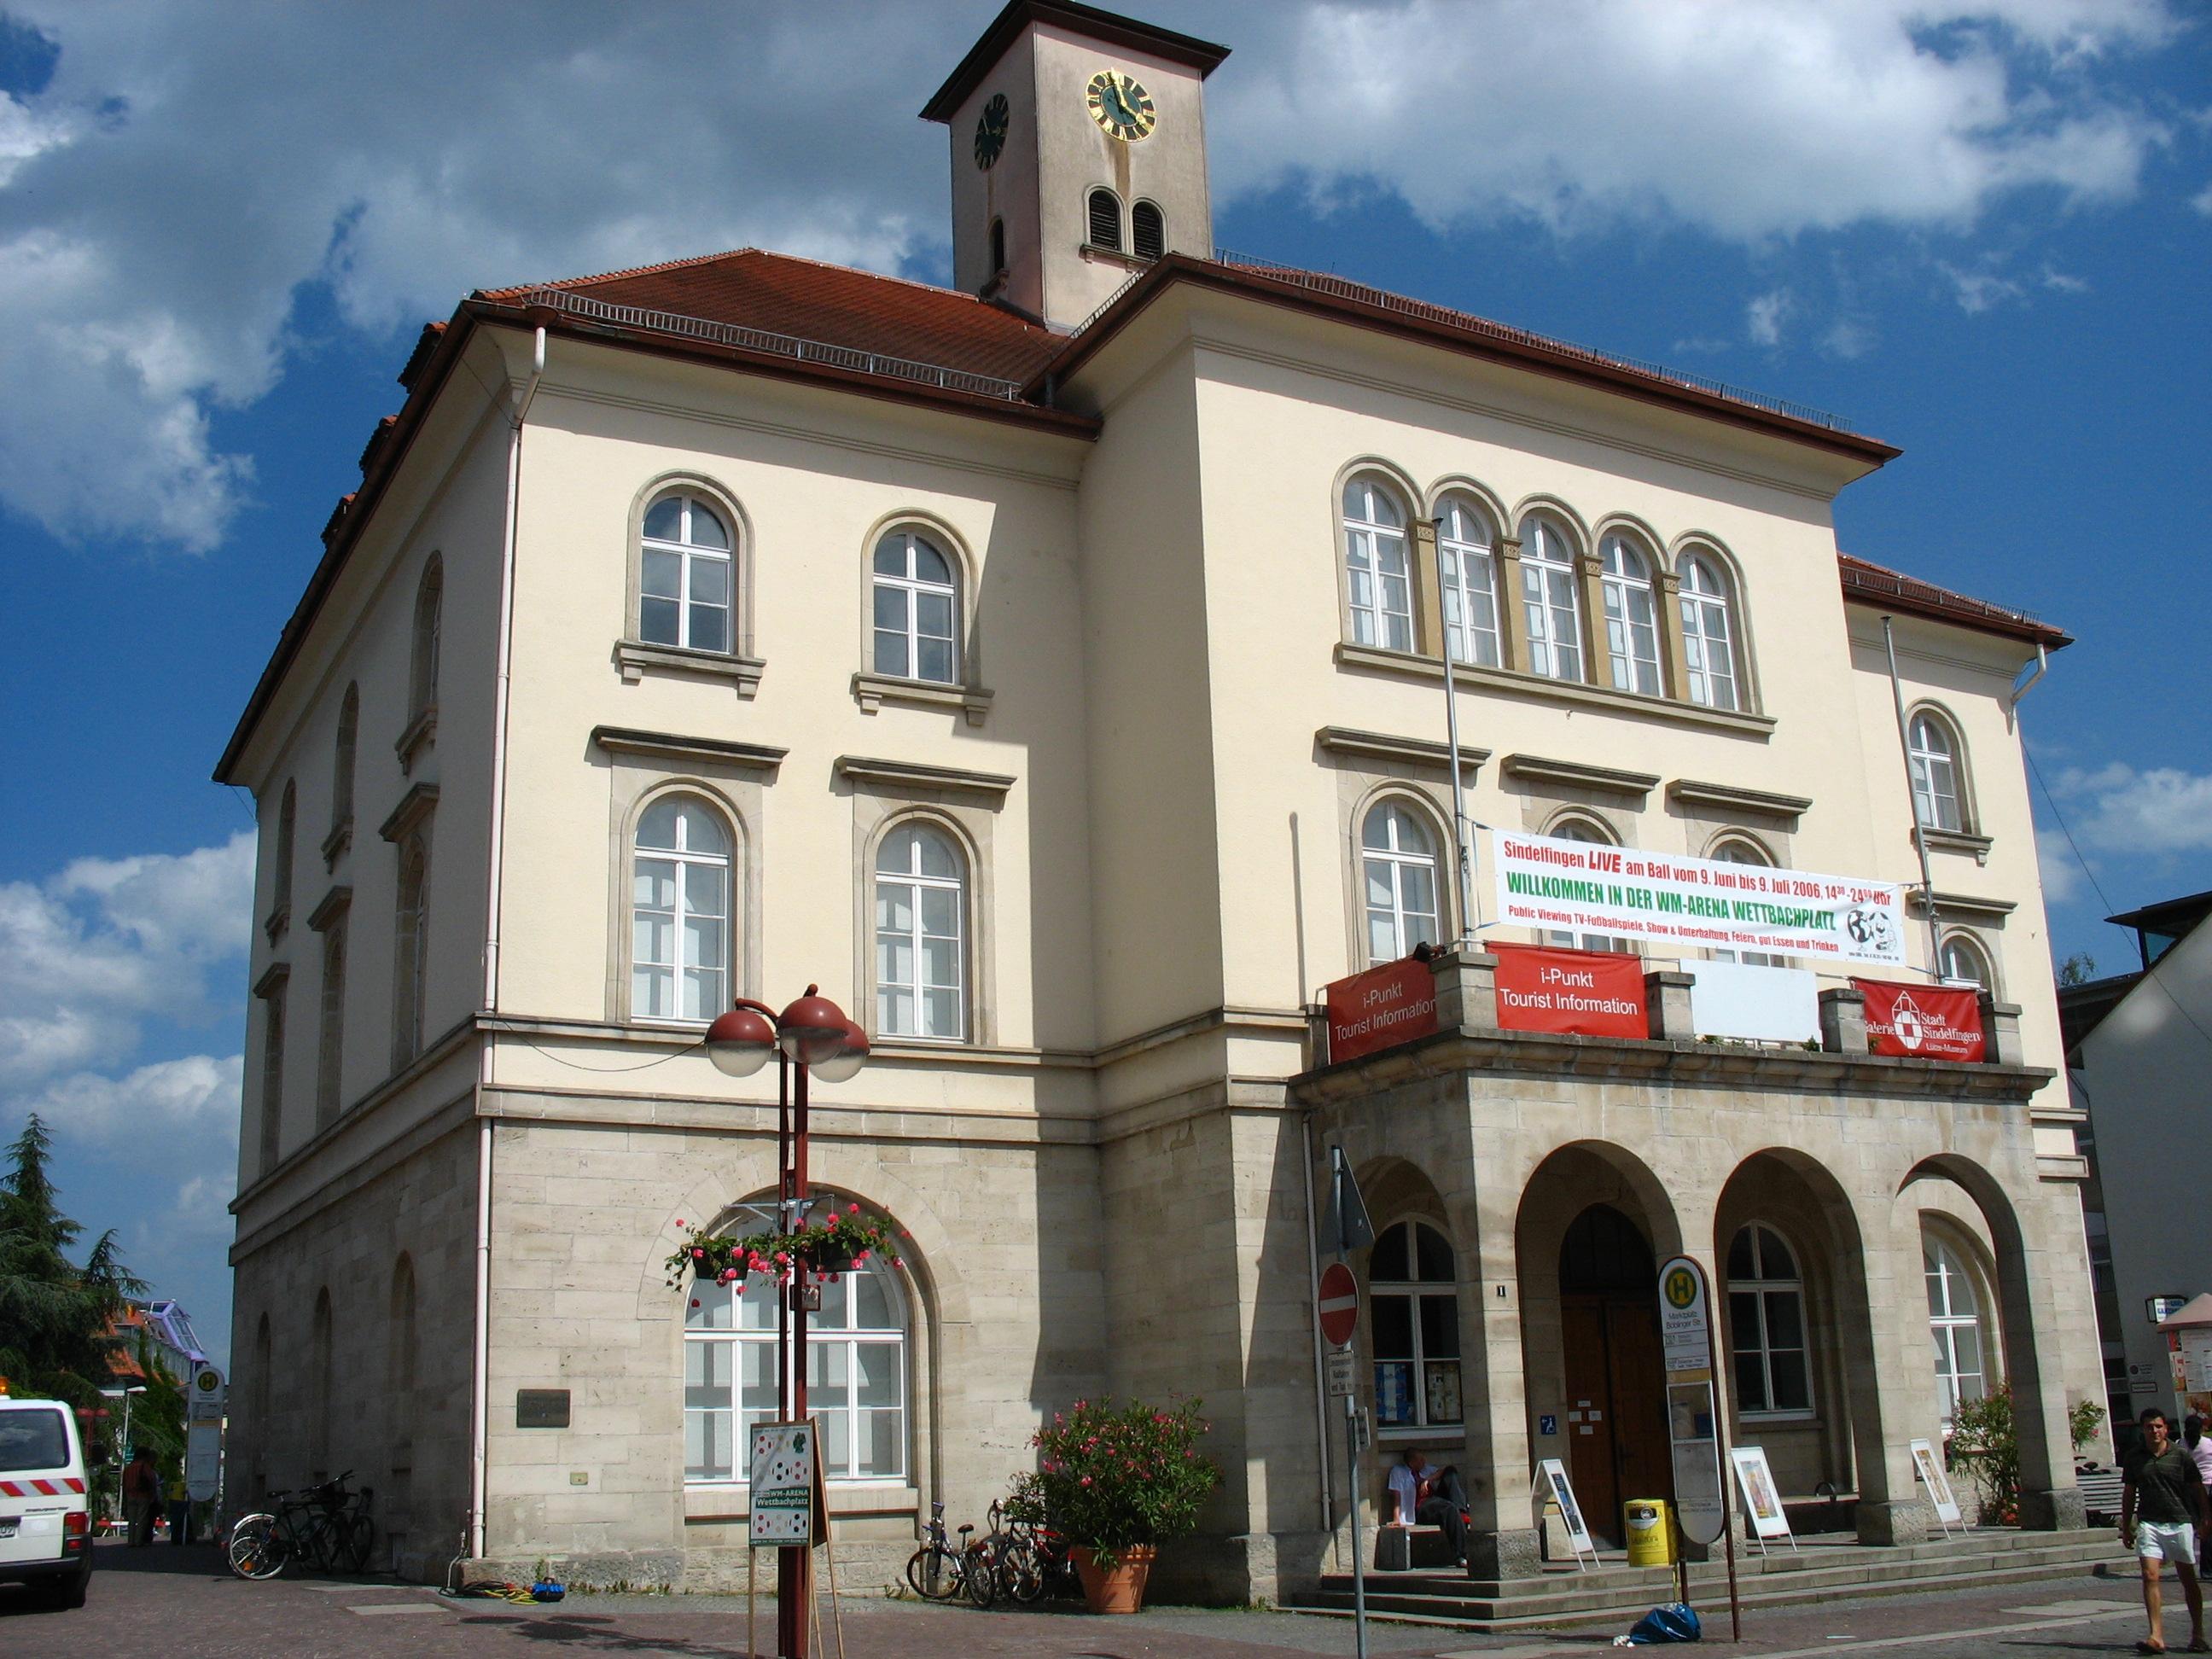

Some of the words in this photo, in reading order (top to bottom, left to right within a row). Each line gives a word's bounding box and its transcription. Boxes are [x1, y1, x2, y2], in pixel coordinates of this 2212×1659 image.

[1504, 841, 1585, 868] Sindelfingen
[1589, 850, 1621, 873] LIVE
[1626, 861, 1644, 876] am
[1647, 862, 1671, 880] Ball
[1673, 867, 1698, 883] vom
[1701, 869, 1711, 885] 9.
[1714, 870, 1737, 888] Juni
[1738, 873, 1756, 891] bis
[1759, 876, 1769, 892] 9.
[1772, 878, 1790, 894] Juli
[1873, 890, 1891, 905] Uhr
[1506, 871, 1604, 904] WILLKOMMEN
[1608, 884, 1623, 906] IN
[1626, 887, 1653, 910] DER
[1656, 890, 1731, 919] WM-ARENA
[1732, 900, 1837, 931] WETTBACHPLATZ
[1508, 905, 1535, 918] Public
[1537, 908, 1572, 923] Viewing
[1647, 922, 1668, 934] Show
[1670, 927, 1676, 935] &
[1759, 936, 1771, 946] gut
[1773, 936, 1794, 947] Essen
[1796, 940, 1810, 950] und
[1812, 940, 1839, 952] Trinken
[1540, 968, 1594, 987] i-Punkt
[1363, 981, 1403, 1009] i-Punkt
[1500, 988, 1551, 1009] Tourist
[1556, 993, 1638, 1016] Information
[1335, 1016, 1371, 1041] Tourist
[1921, 1012, 1946, 1027] Stadt
[1923, 1026, 1981, 1044] Sindelfingen
[757, 1497, 808, 1507] Wettbachplatz
